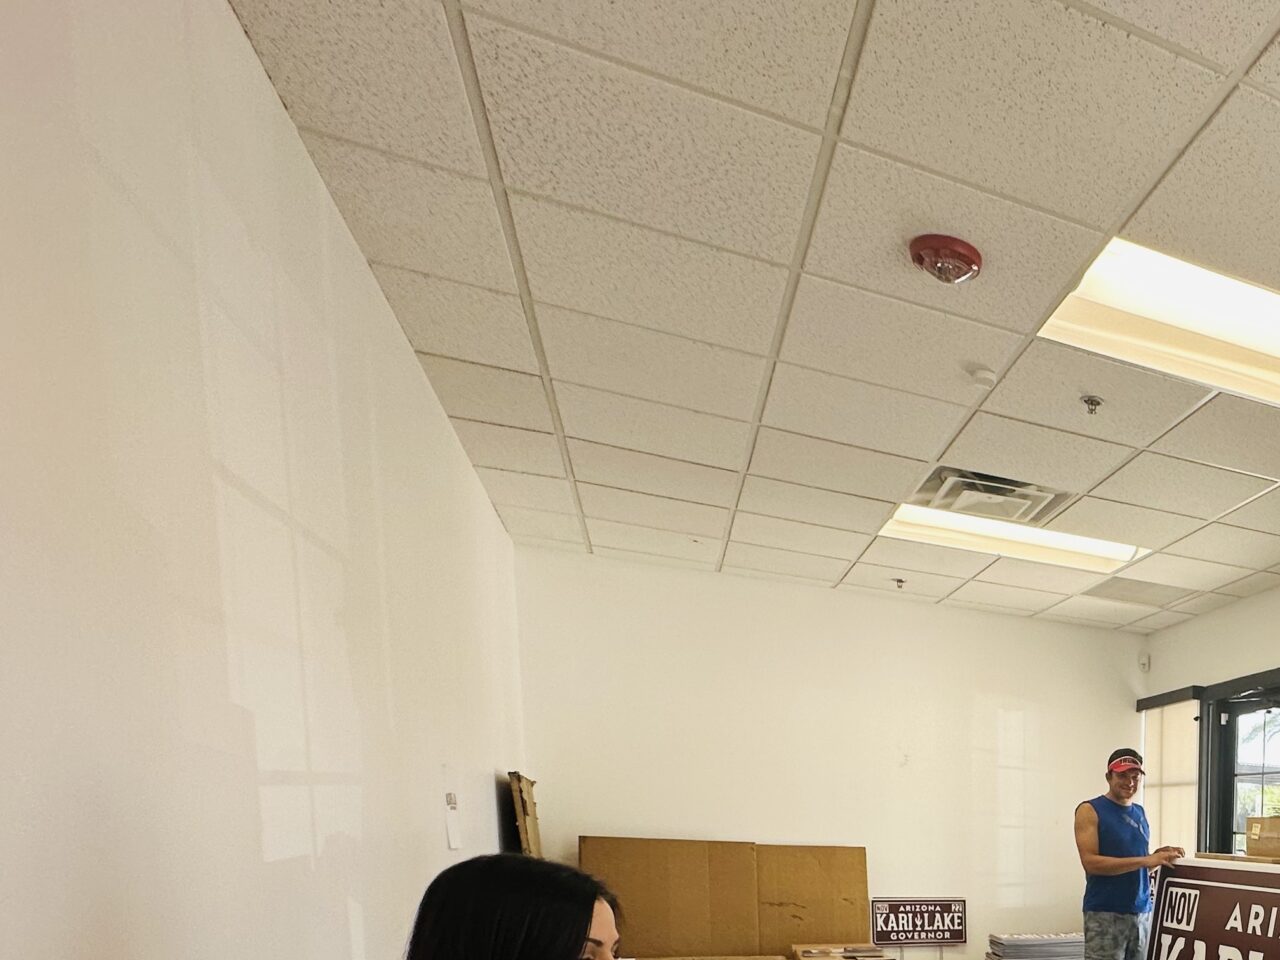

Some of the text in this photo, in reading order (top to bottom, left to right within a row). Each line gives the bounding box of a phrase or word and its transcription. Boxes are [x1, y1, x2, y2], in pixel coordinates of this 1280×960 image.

[899, 904, 941, 912] ARIZONA
[1165, 890, 1198, 926] NOV
[876, 912, 963, 931] KARI LAKE
[890, 931, 951, 940] GOVERNOR
